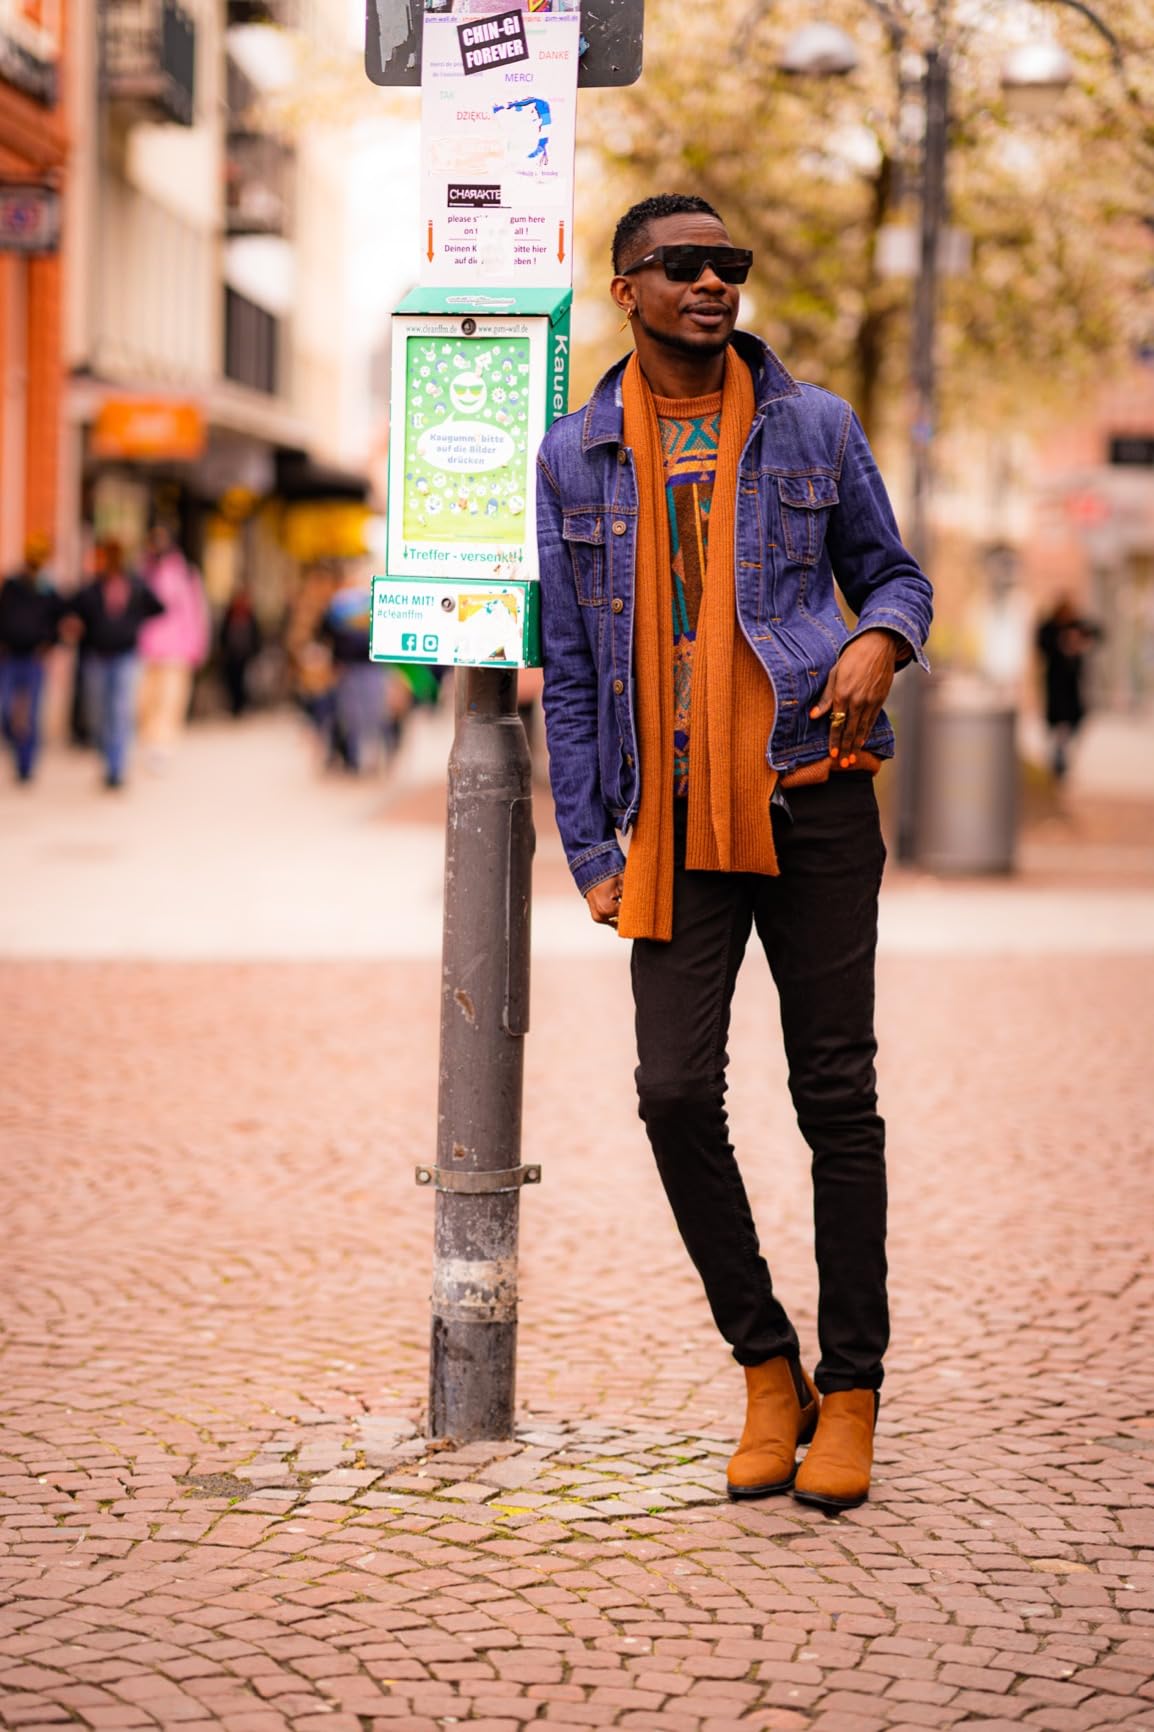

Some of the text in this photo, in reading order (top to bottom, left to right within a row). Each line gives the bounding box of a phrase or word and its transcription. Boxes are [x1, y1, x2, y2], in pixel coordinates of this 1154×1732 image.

[462, 15, 520, 46] CHIN-GI
[465, 38, 524, 68] FOREVER
[538, 50, 569, 60] DANKE
[505, 73, 534, 82] MERCI
[447, 215, 472, 224] please
[509, 216, 526, 225] gum
[528, 215, 546, 224] here
[463, 228, 474, 236] on
[514, 227, 524, 236] all
[444, 244, 471, 253] Deinen
[532, 245, 548, 254] hier
[454, 256, 467, 265] auf
[406, 323, 529, 335] www.cleanffm.de www.gum-wall.de
[430, 433, 505, 443] Kaugumm bitte
[436, 444, 497, 454] auf die Bilder
[447, 455, 485, 465] drücken
[409, 548, 450, 561] Treffer
[378, 593, 435, 607] MACH MIT!
[377, 608, 423, 620] #cleanffm
